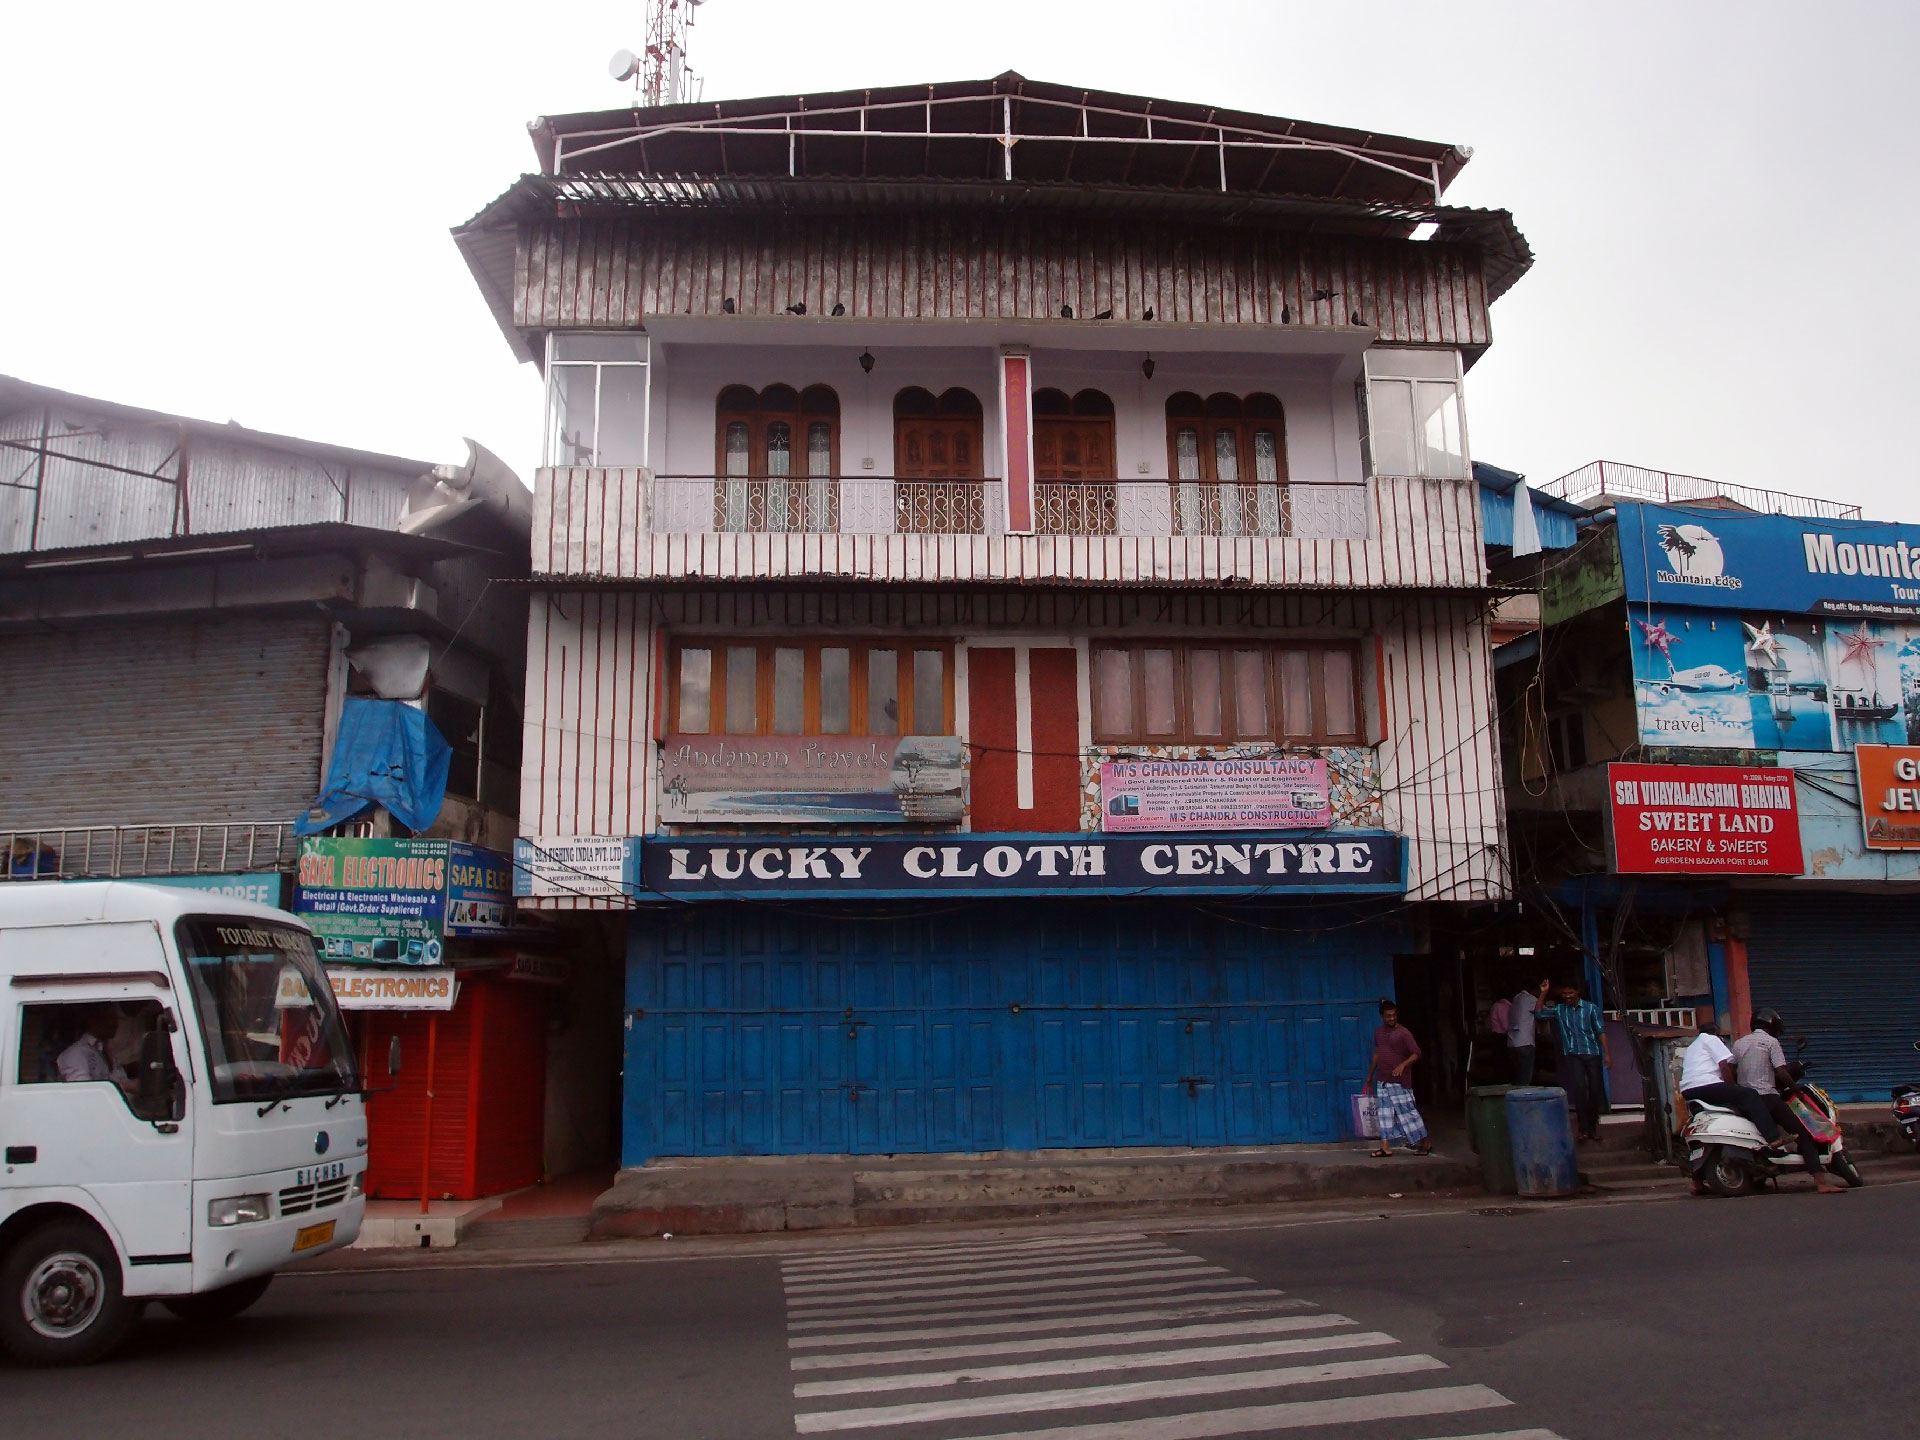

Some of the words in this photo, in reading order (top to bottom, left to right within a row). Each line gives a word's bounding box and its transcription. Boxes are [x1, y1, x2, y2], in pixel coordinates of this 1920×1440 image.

[1657, 570, 1712, 585] Mountain
[1714, 575, 1742, 589] Edge
[1655, 717, 1706, 733] travel
[673, 742, 789, 768] Andaman
[800, 742, 888, 769] Travels
[1113, 763, 1137, 778] M/S
[1142, 762, 1209, 777] CHANDRA
[1214, 760, 1316, 776] CONSULTANCY
[1615, 780, 1639, 805] SRI
[1640, 781, 1739, 808] VIJAYALAKSHMI
[1741, 784, 1792, 810] BHAVAN
[1169, 812, 1187, 823] M/S
[1189, 811, 1237, 821] CHANDRA
[1240, 810, 1318, 821] CONSTRUCTION
[1638, 811, 1714, 832] SWEET
[1719, 813, 1774, 833] LAND
[548, 847, 574, 862] FISHING
[575, 846, 594, 862] INDIA
[595, 846, 609, 862] PVT.
[609, 846, 622, 862] LTD
[1651, 837, 1701, 853] BAKERY
[1706, 838, 1715, 853] &
[1720, 839, 1768, 854] SWEETS
[668, 846, 872, 880] LUCKY
[902, 845, 1106, 878] CLOTH
[1140, 842, 1373, 876] CENTRE
[1655, 856, 1695, 865] ABERDEEN
[1696, 857, 1726, 865] BAZAAR
[1727, 857, 1746, 866] PORT
[1748, 858, 1769, 866] BLAIR
[299, 855, 335, 887] SAFA
[342, 856, 445, 891] ELECTRONICS
[451, 864, 483, 889] SAFA
[302, 891, 338, 900] Electrical
[339, 892, 345, 901] &
[346, 892, 389, 903] Electronics
[390, 893, 428, 904] Wholesale
[430, 896, 436, 904] &
[314, 902, 336, 911] Retail
[216, 926, 273, 948] TOURIST
[330, 977, 449, 998] ELECTRONICS
[297, 1162, 345, 1186] EICHER
